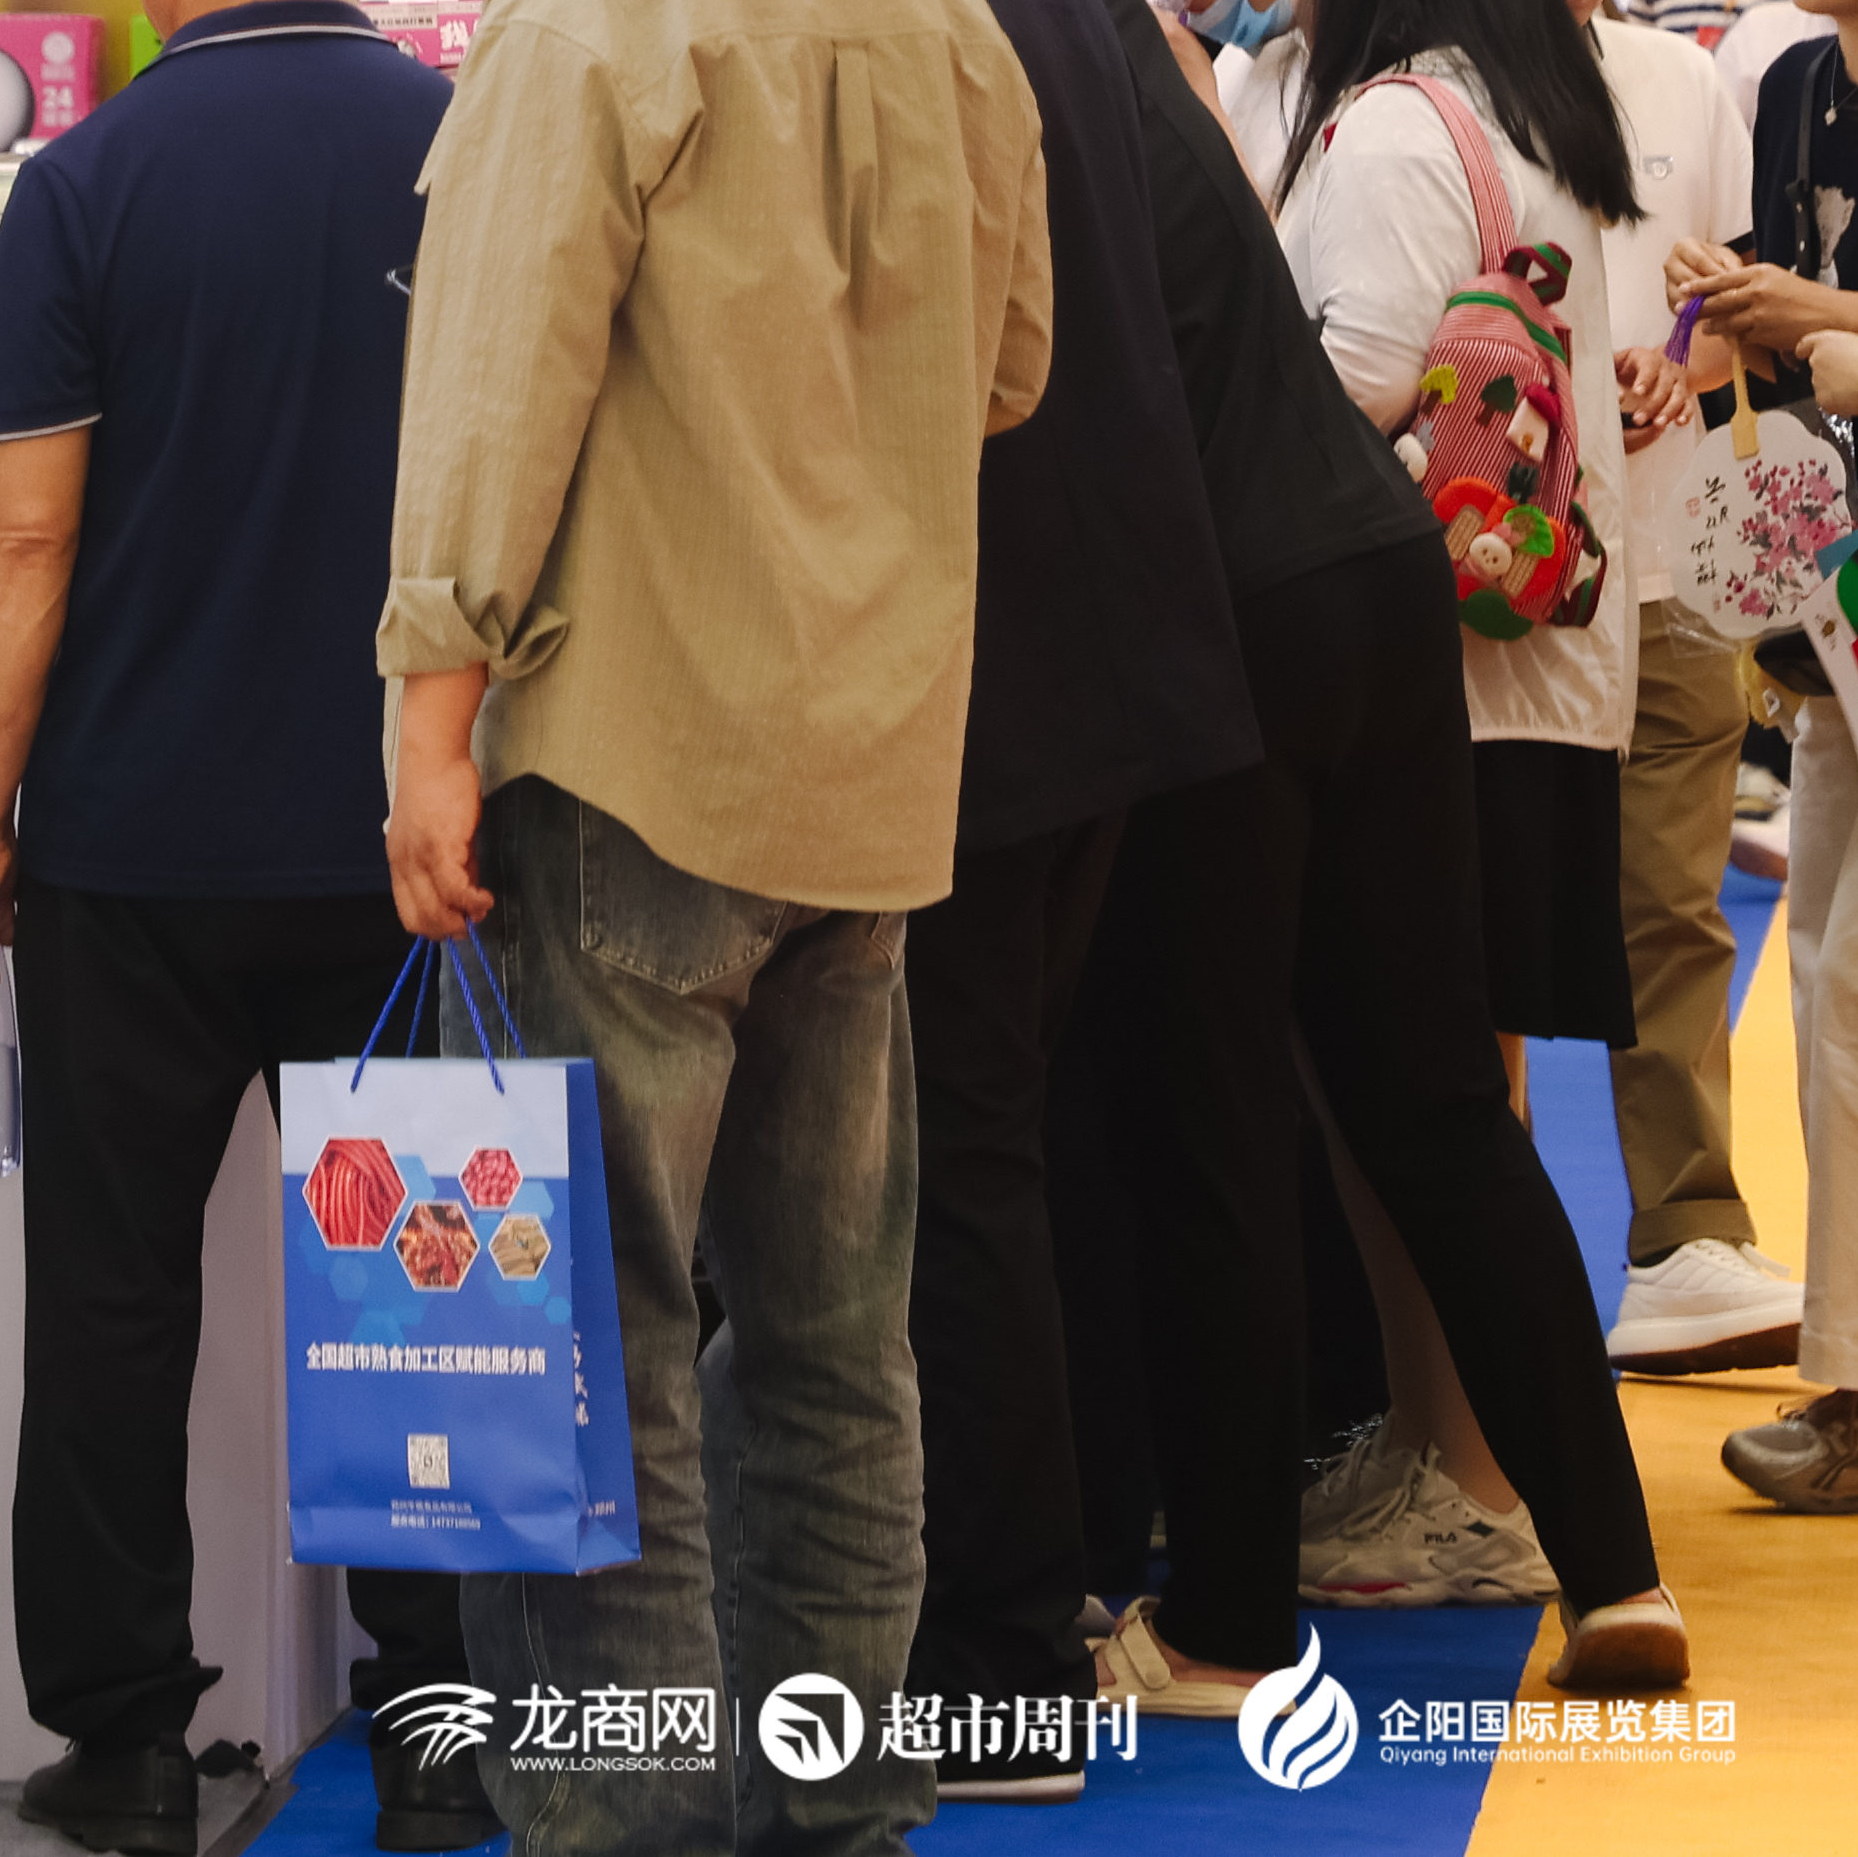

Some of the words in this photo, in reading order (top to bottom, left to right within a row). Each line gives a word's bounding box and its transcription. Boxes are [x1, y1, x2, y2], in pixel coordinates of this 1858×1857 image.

[42, 86, 75, 109] 24
[305, 1340, 546, 1377] 全国超市熟食加工区赋能服务商
